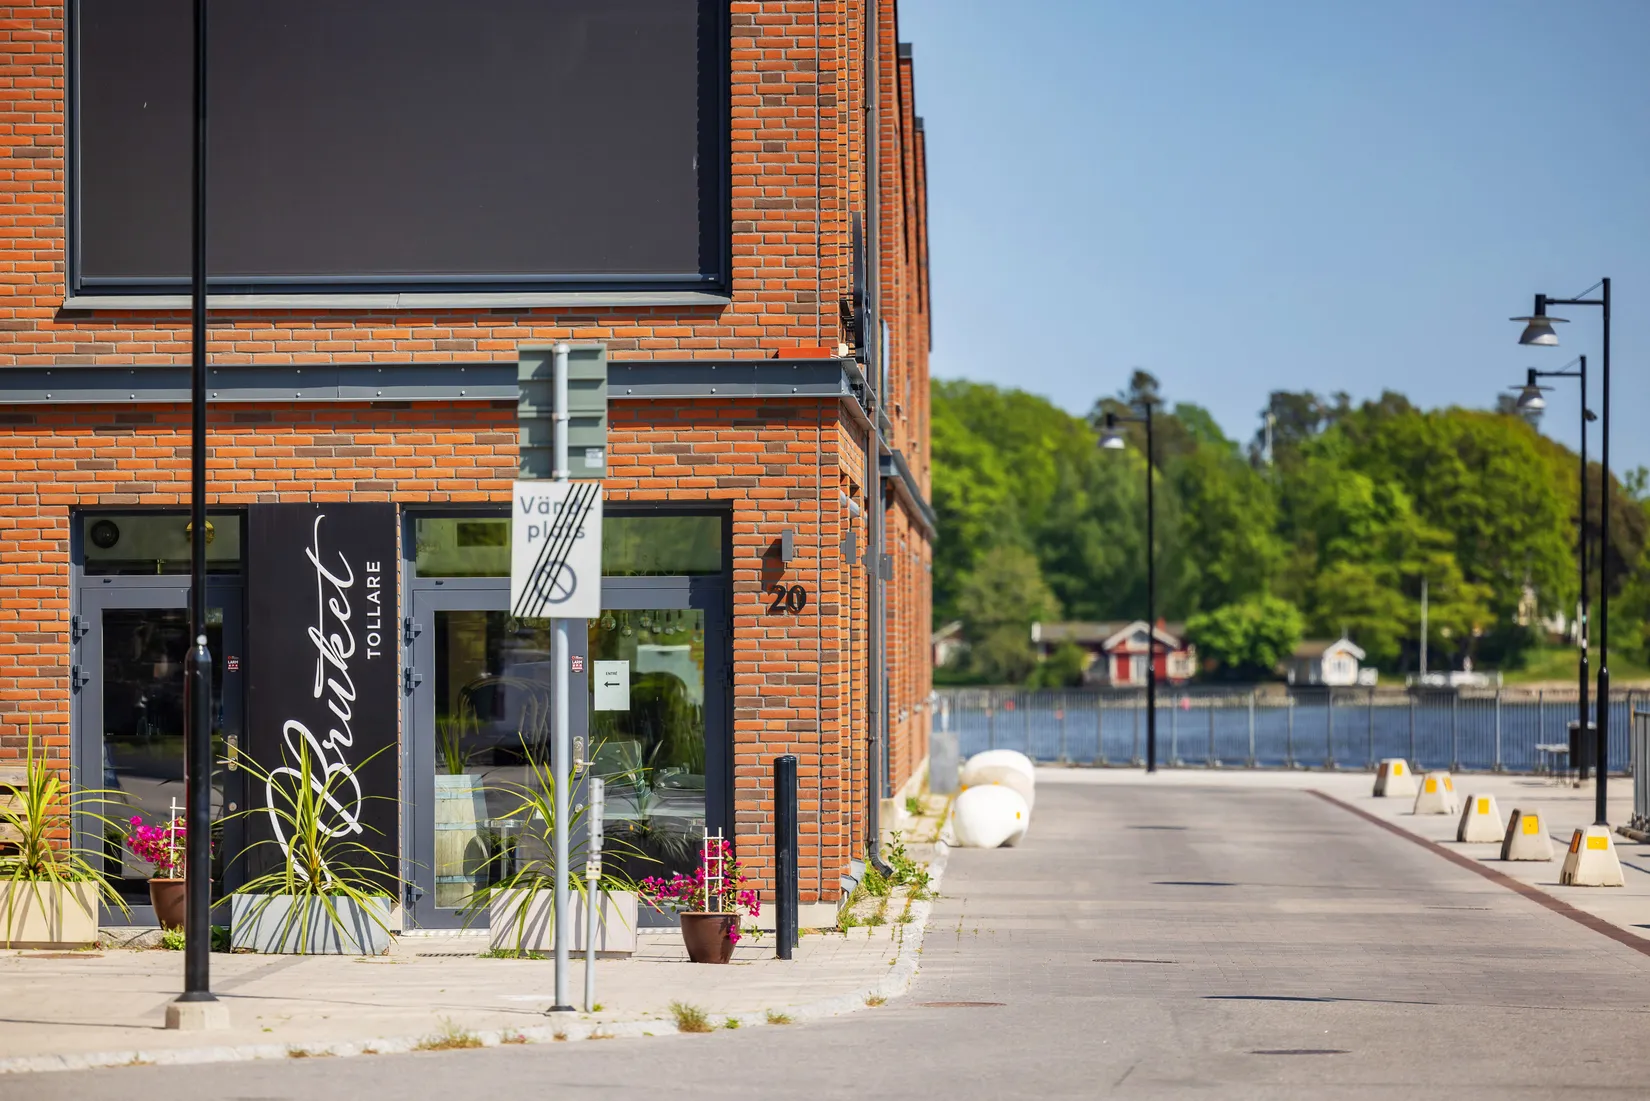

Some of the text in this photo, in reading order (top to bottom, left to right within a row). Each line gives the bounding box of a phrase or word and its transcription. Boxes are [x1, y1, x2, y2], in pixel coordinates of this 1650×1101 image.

[520, 496, 594, 515] Vänd-
[527, 521, 585, 542] plats
[366, 560, 381, 660] TOLLARE
[768, 584, 807, 614] 20
[266, 514, 363, 890] Bruket
